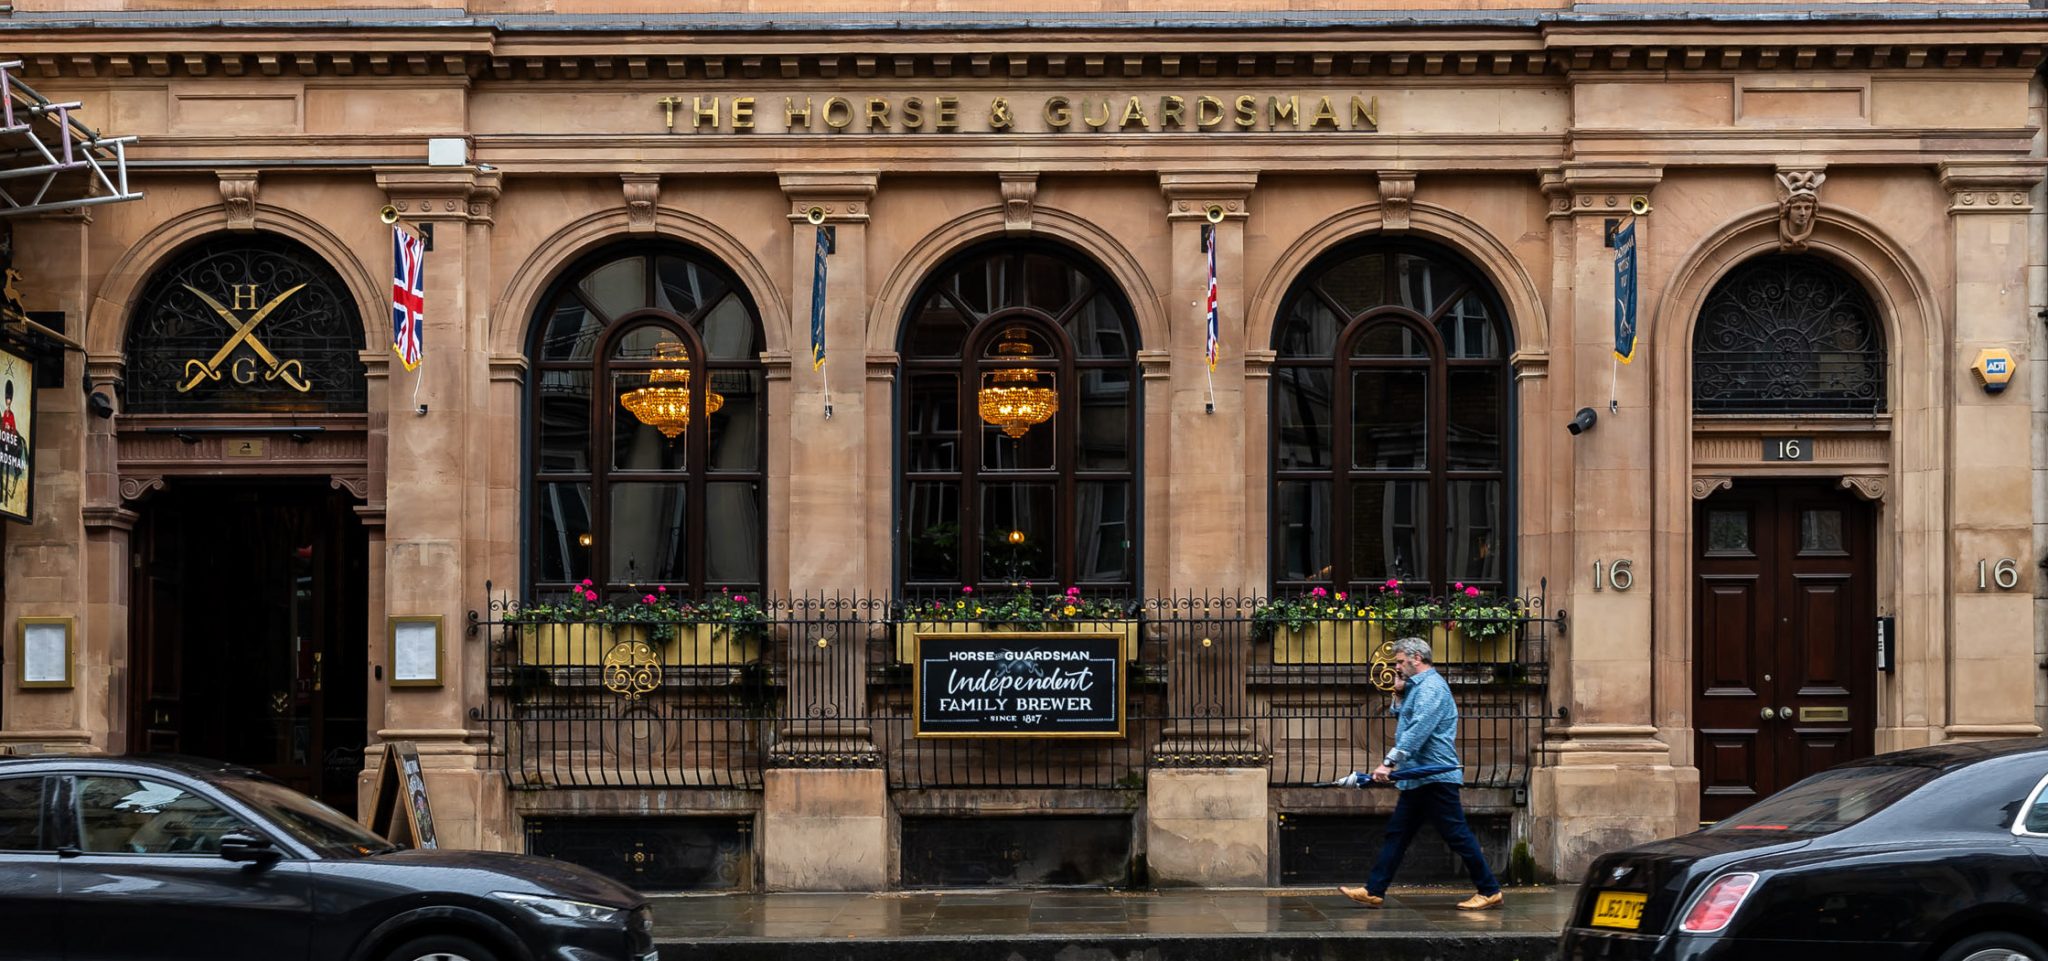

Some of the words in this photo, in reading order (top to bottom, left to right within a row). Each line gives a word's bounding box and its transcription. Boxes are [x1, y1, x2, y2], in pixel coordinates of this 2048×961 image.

[656, 96, 755, 128] THE
[785, 96, 959, 128] HORSE
[988, 96, 1015, 129] &
[1043, 95, 1379, 128] GUARDSMAN
[231, 284, 259, 310] H
[232, 357, 257, 384] G
[1987, 361, 2006, 371] ADT
[1779, 440, 1800, 459] 16
[1593, 559, 1633, 592] 16
[1978, 558, 2018, 591] 16
[949, 651, 994, 661] HORSE
[1004, 651, 1090, 661] GUARDSMAN
[948, 667, 1093, 696] Independent
[939, 698, 1008, 712] FAMILY
[1016, 697, 1093, 711] BREWER
[1022, 714, 1042, 724] 1827
